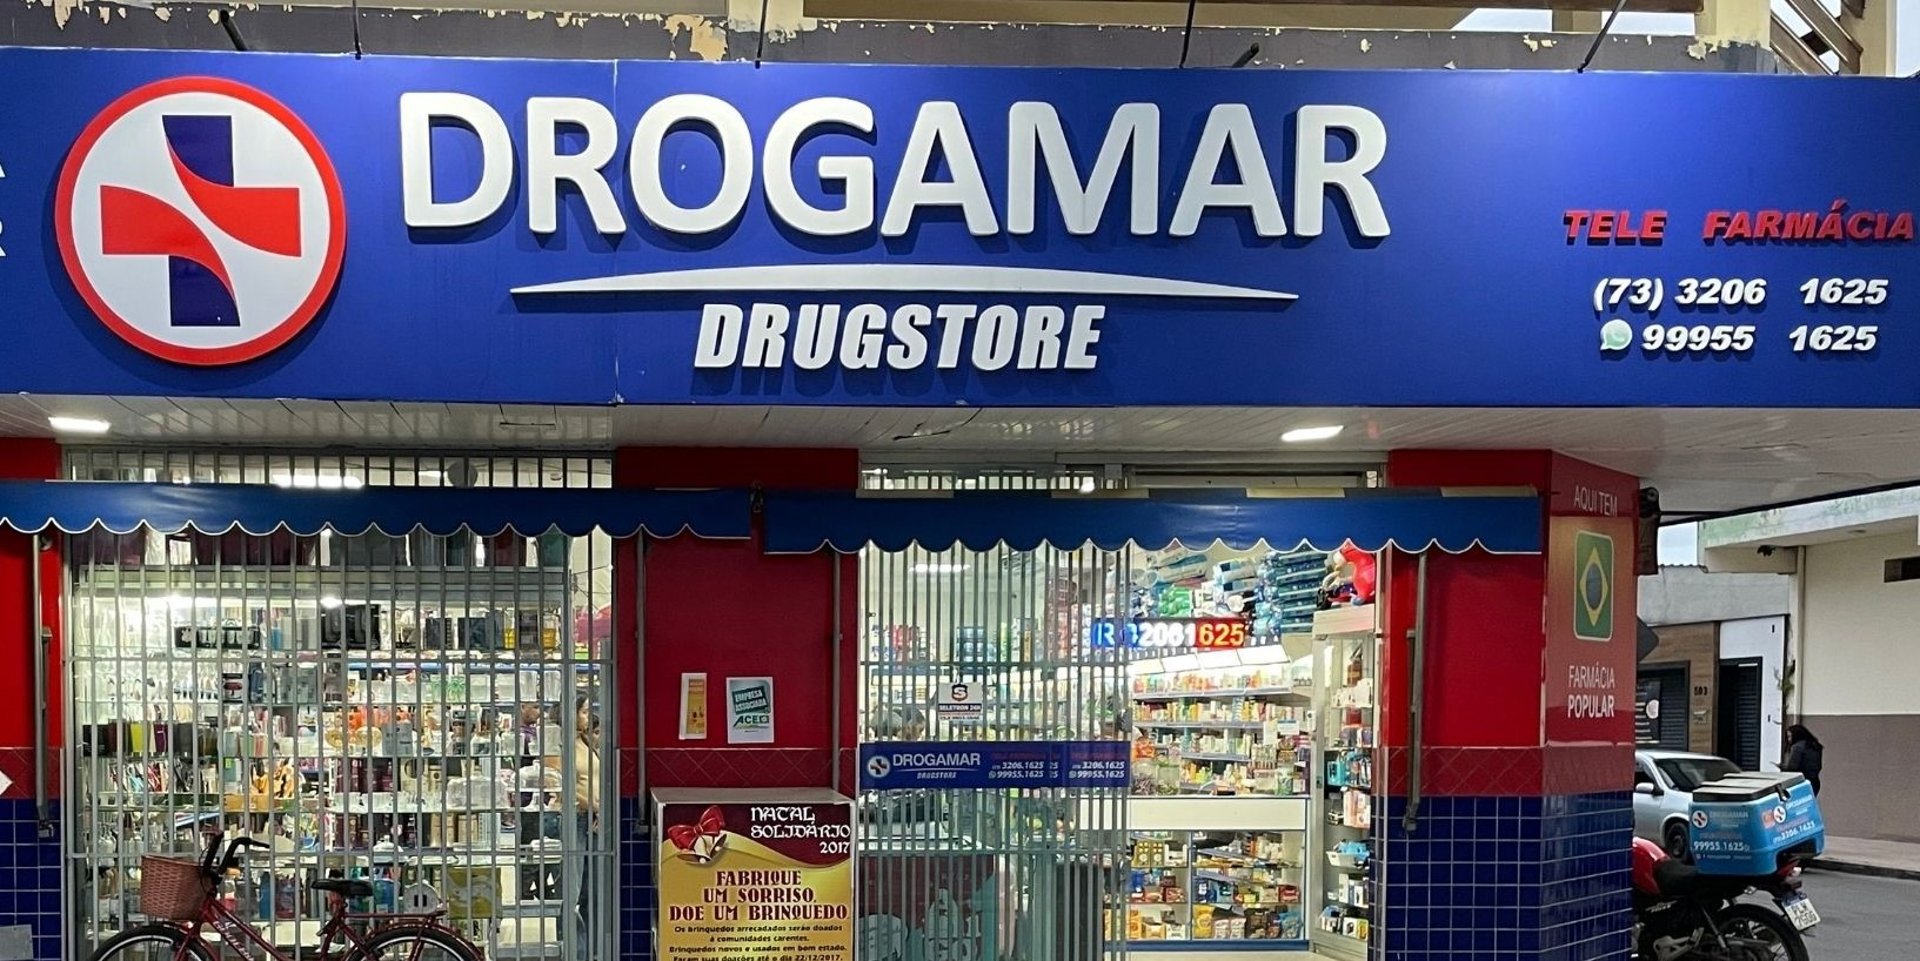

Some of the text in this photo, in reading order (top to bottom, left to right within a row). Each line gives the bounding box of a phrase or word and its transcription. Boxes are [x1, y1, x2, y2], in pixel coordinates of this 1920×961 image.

[399, 92, 1390, 237] DROGAMAR
[1563, 199, 1915, 241] TELE FARMÁCIA
[1593, 278, 1889, 311] (73) 3206 1625
[693, 303, 1106, 370] DRUGSTORE
[1642, 325, 1878, 352] 99955 1625
[1574, 486, 1618, 517] AQUI TEM
[1568, 661, 1616, 689] FARMÁCIA
[1567, 694, 1615, 718] POPULAR
[892, 753, 981, 767] DROGAMAR
[750, 807, 816, 822] NATAL
[750, 821, 851, 839] SOLIDÁRIO
[819, 841, 851, 854] 2017
[716, 870, 802, 886] FABRIQUE
[703, 887, 727, 903] UM
[669, 905, 705, 921] DOE
[714, 905, 739, 921] UM
[688, 926, 735, 934] brinquedos
